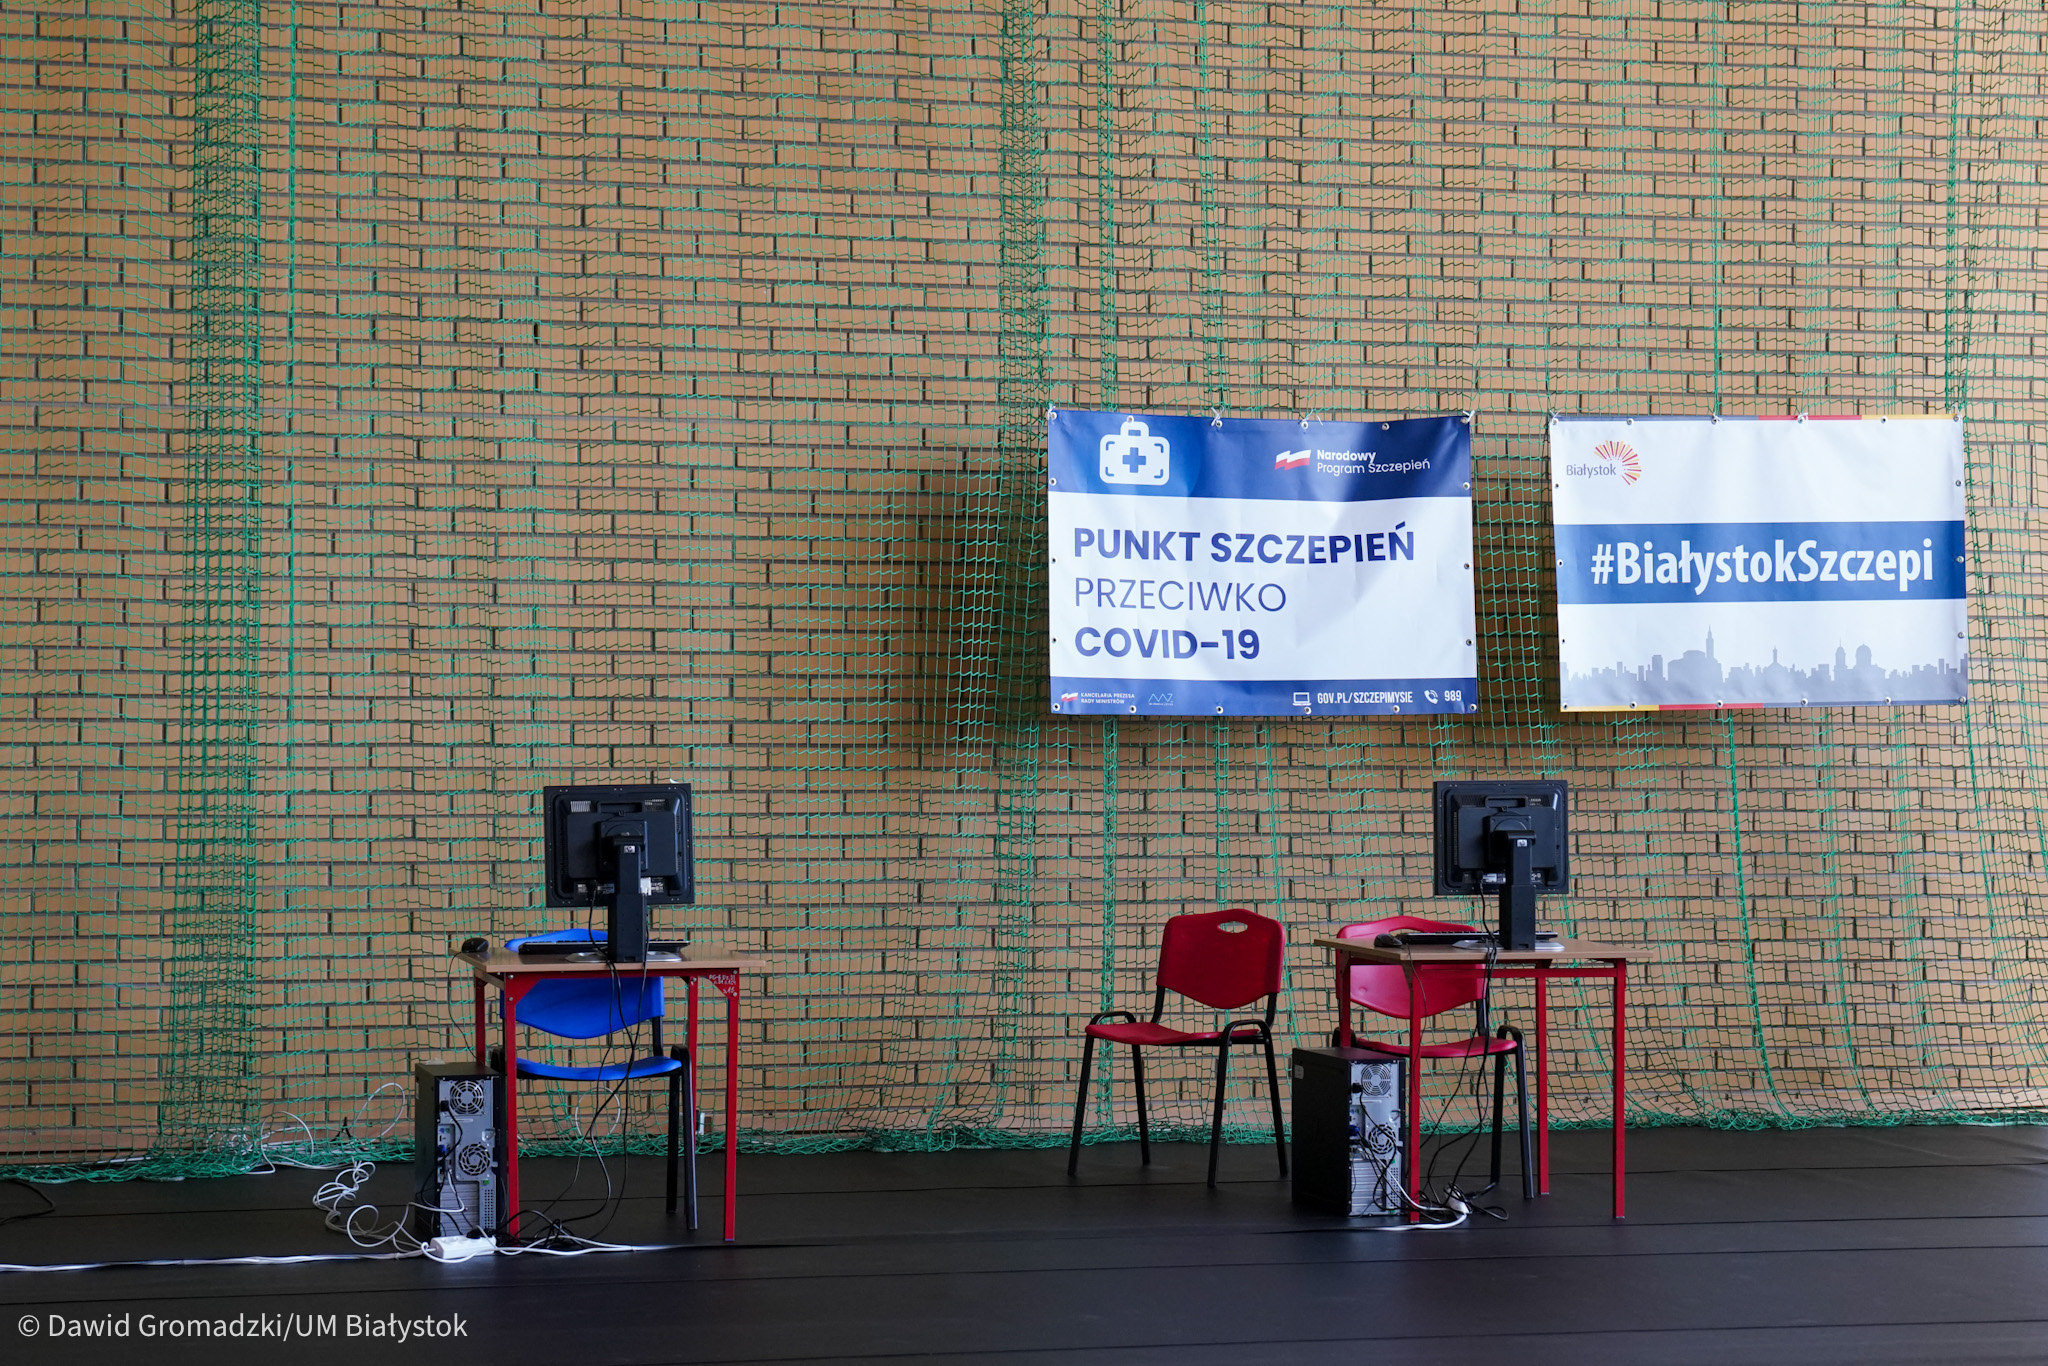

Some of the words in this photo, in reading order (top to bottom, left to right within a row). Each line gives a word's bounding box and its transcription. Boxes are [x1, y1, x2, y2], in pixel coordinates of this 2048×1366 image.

[1317, 449, 1376, 463] Narodowy
[1317, 462, 1365, 477] Program
[1368, 458, 1431, 474] Szczepień
[1566, 463, 1617, 479] Białystok
[1074, 527, 1201, 562] PUNKT
[1210, 521, 1415, 565] SZCZEPIEŃ
[1591, 538, 1933, 595] #BiałystokSzczepi
[1075, 577, 1287, 612] PRZECIWKO
[1075, 627, 1260, 660] COVID-19
[1317, 691, 1413, 704] GOV.PL/SZCZEPIMYSIE
[1444, 690, 1462, 702] 989
